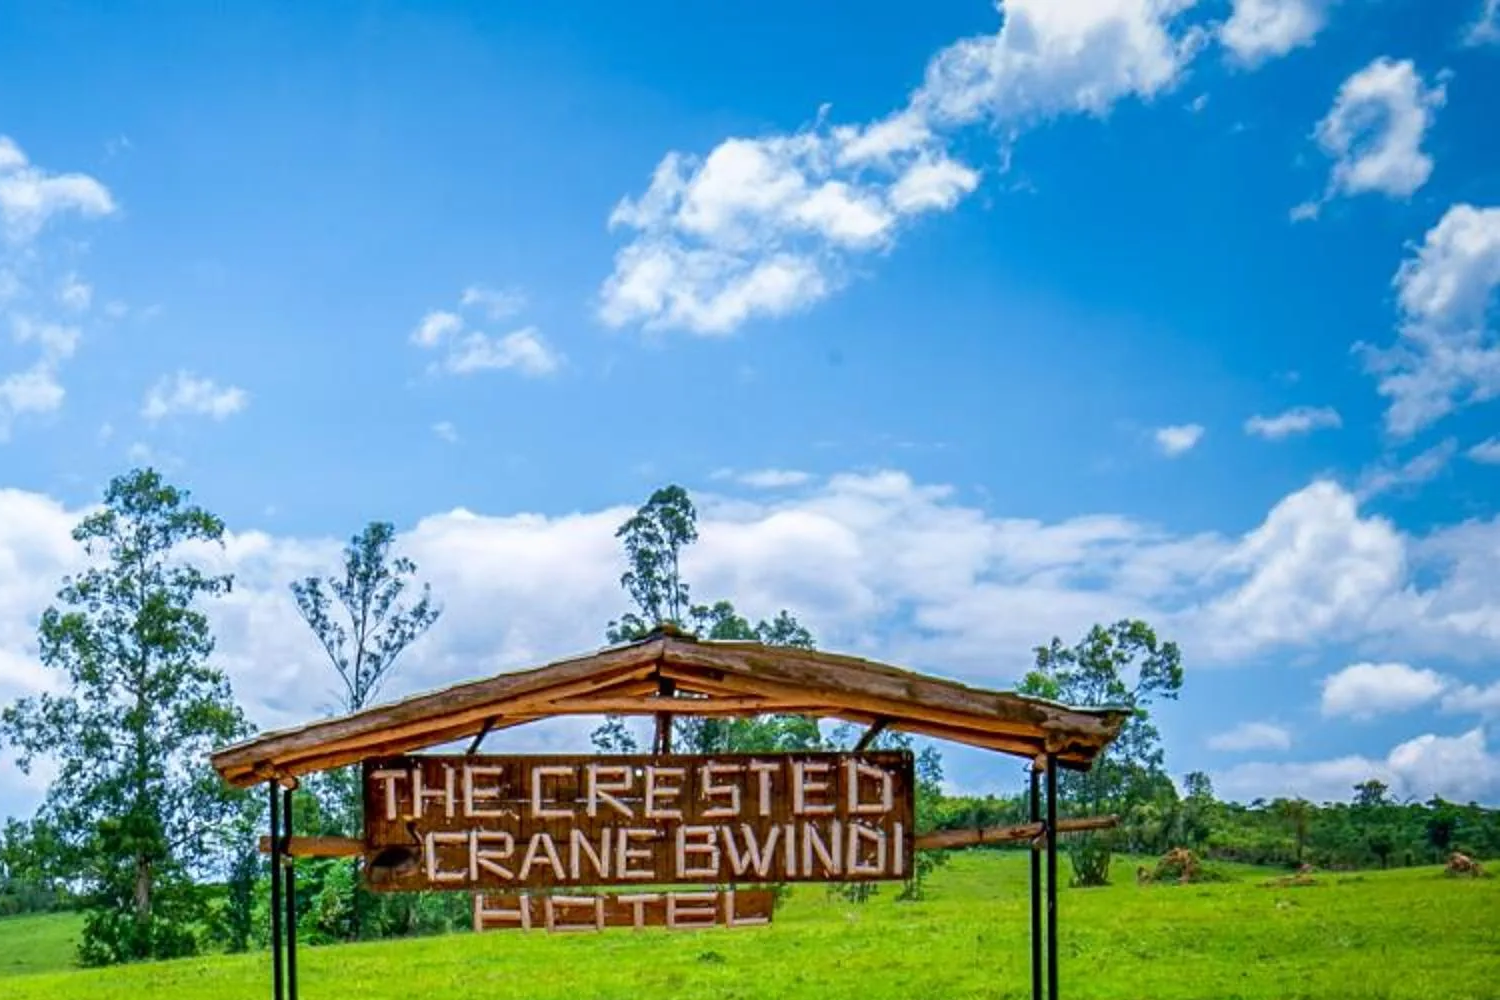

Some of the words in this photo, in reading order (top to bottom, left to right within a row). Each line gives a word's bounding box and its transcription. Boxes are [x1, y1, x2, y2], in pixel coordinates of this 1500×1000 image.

[372, 763, 505, 820] THE
[531, 757, 894, 819] CRESTED
[426, 826, 663, 882] CRANE
[675, 818, 903, 879] BWINDI
[473, 890, 769, 932] HOTEL
